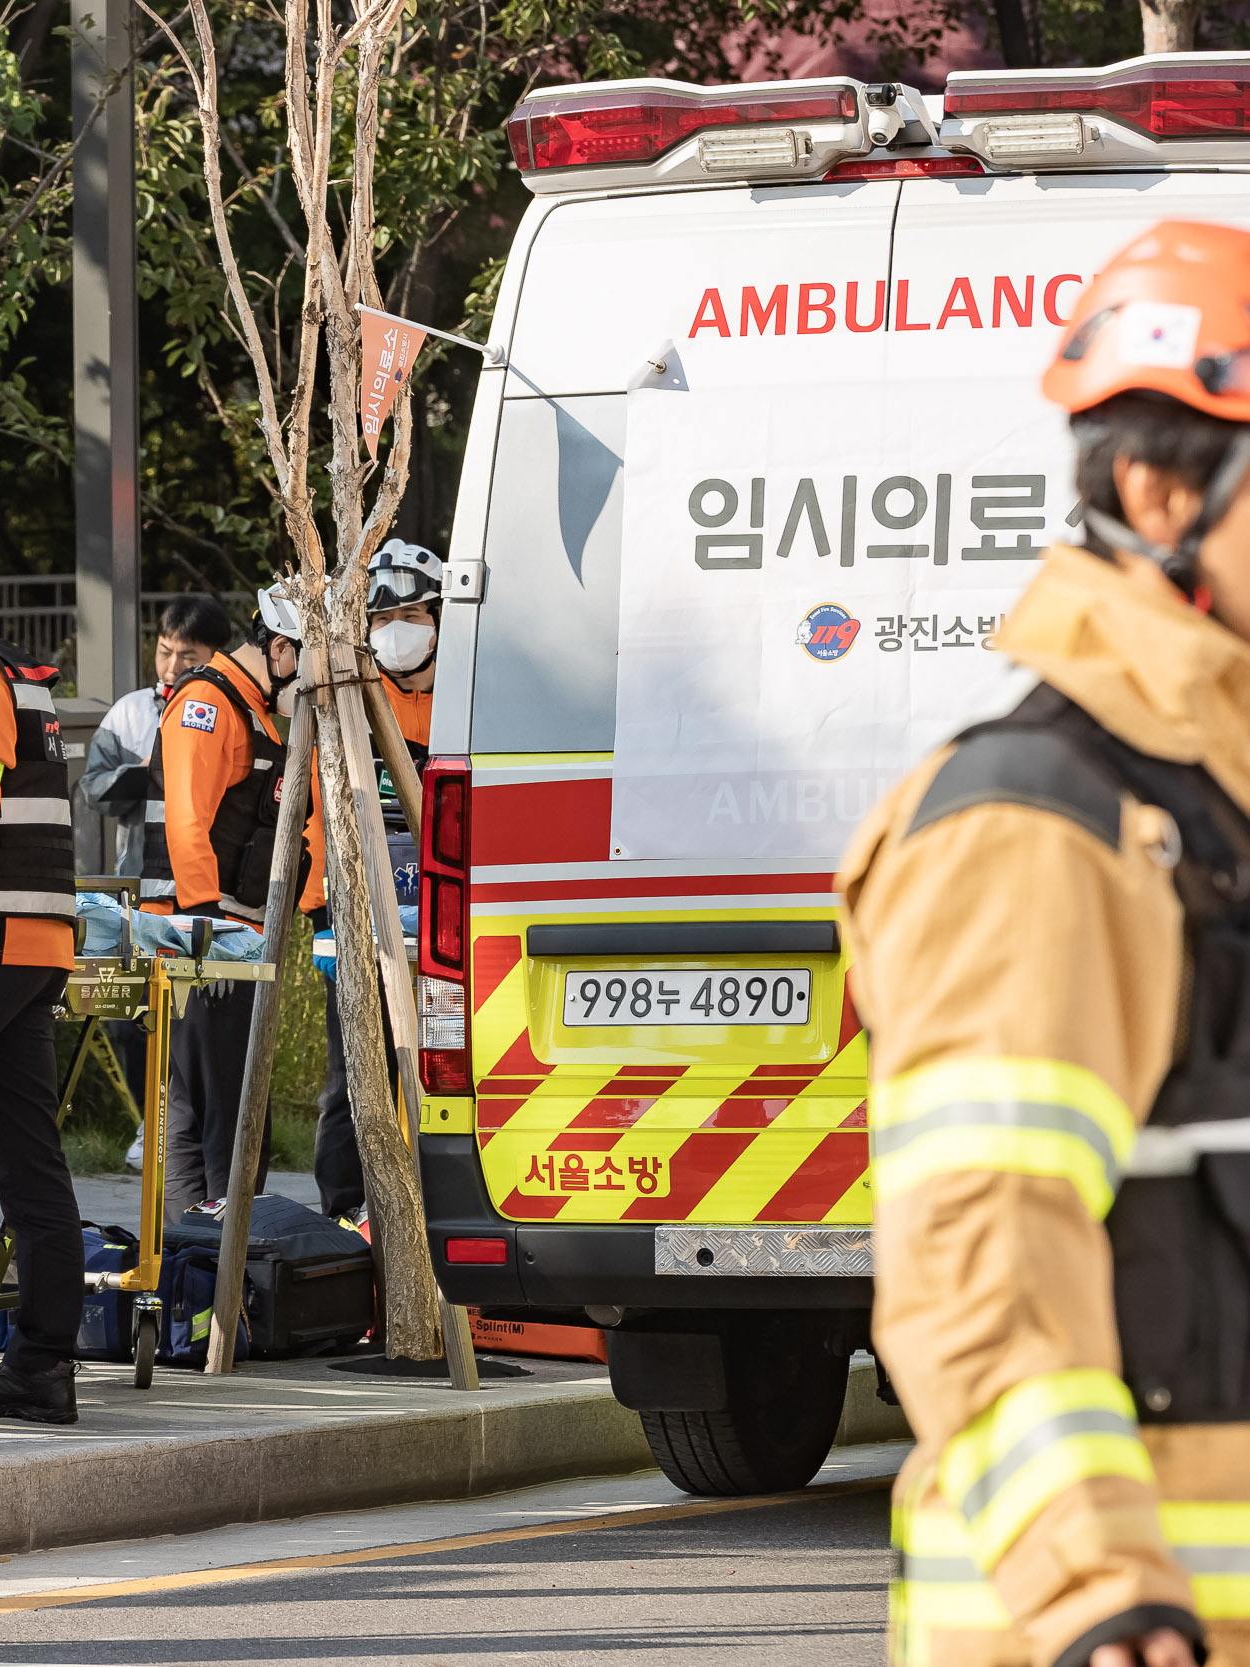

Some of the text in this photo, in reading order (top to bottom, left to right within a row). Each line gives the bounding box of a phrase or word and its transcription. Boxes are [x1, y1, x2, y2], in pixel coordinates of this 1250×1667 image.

[688, 273, 1095, 339] AMBULANC
[364, 327, 399, 436] 임시의료소
[688, 473, 1084, 571] 임시의료
[809, 619, 861, 649] 119
[874, 613, 1007, 652] 광진소방
[816, 649, 839, 657] 서울소방
[184, 720, 212, 732] KOREA
[81, 985, 131, 999] SAVER
[579, 976, 794, 1018] 998누 4890
[524, 1153, 663, 1195] 서울소방
